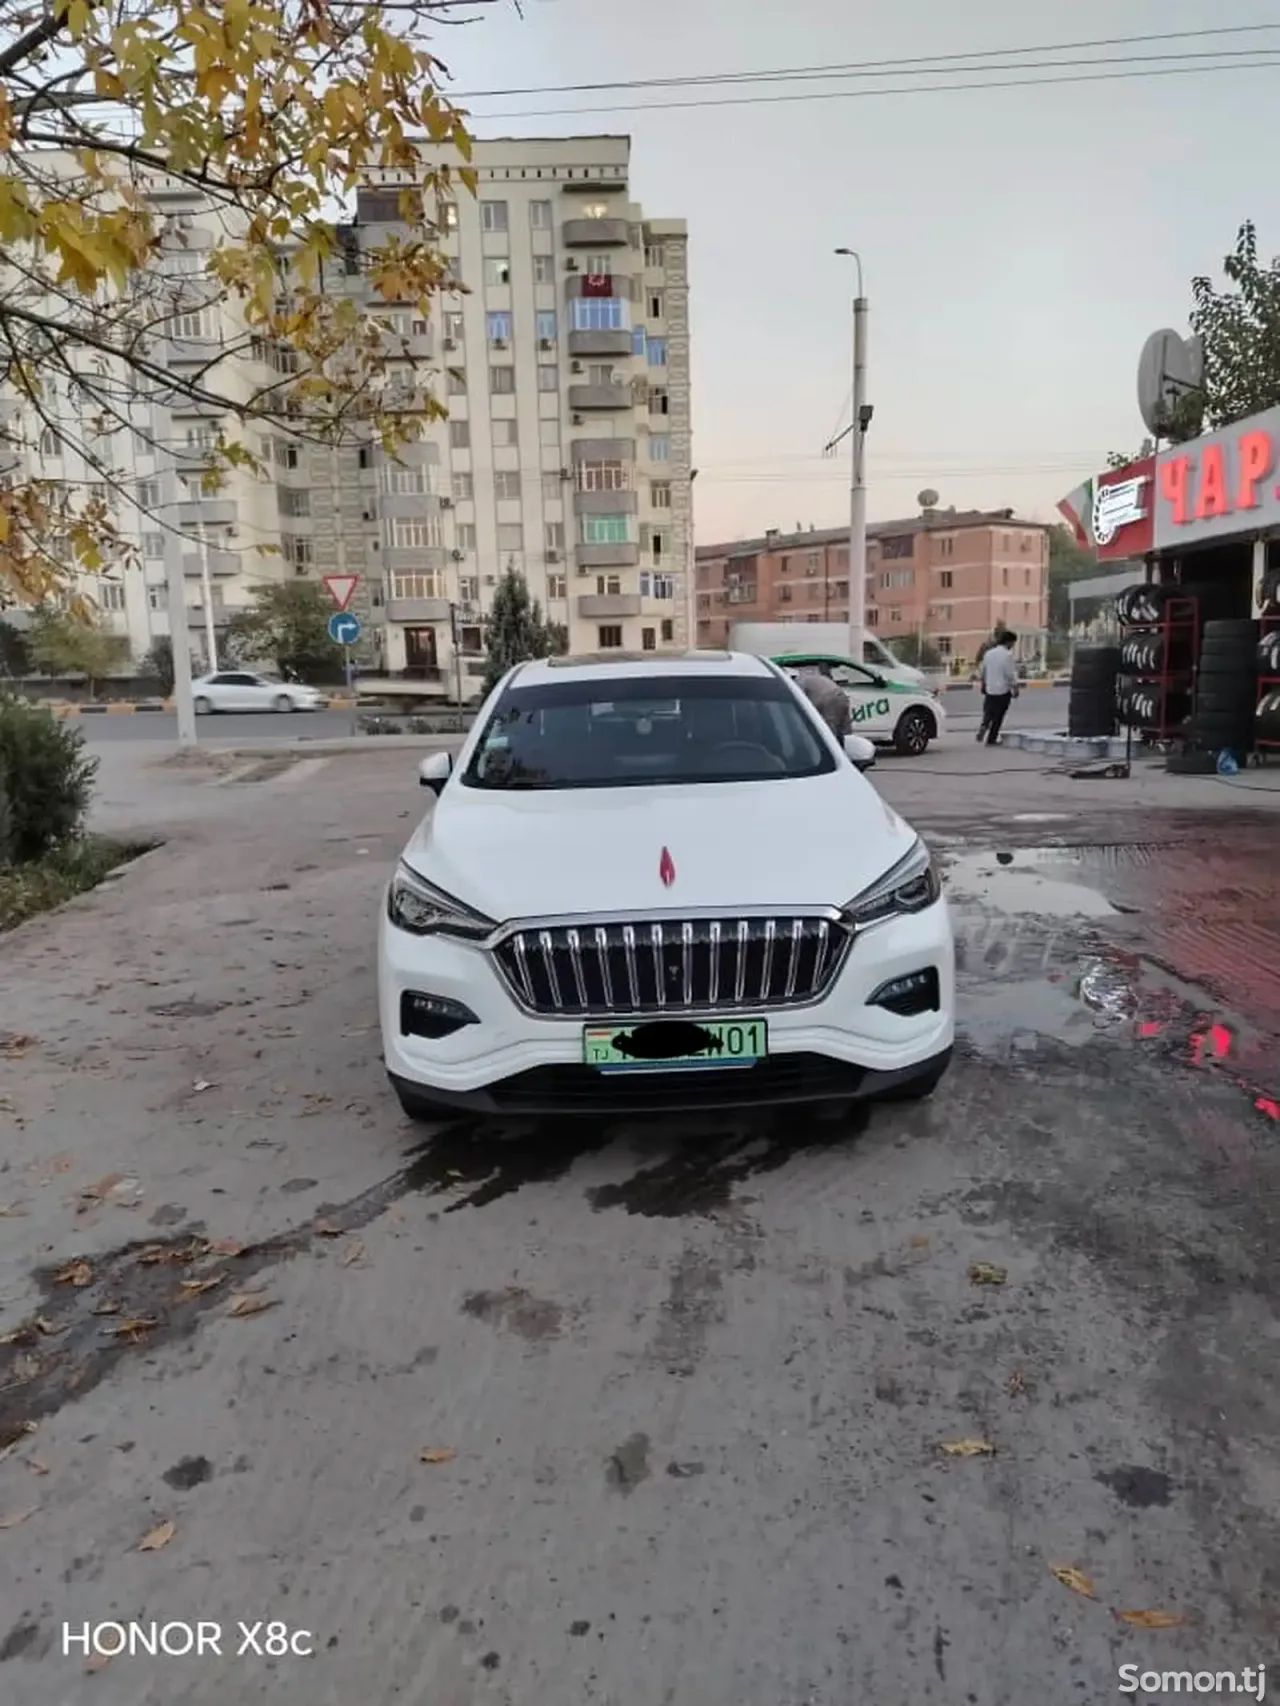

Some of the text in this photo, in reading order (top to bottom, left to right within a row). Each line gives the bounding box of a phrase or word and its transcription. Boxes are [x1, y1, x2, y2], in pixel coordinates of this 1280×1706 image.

[1159, 429, 1280, 525] ЧАР
[850, 697, 890, 722] ara
[593, 1048, 609, 1061] TJ
